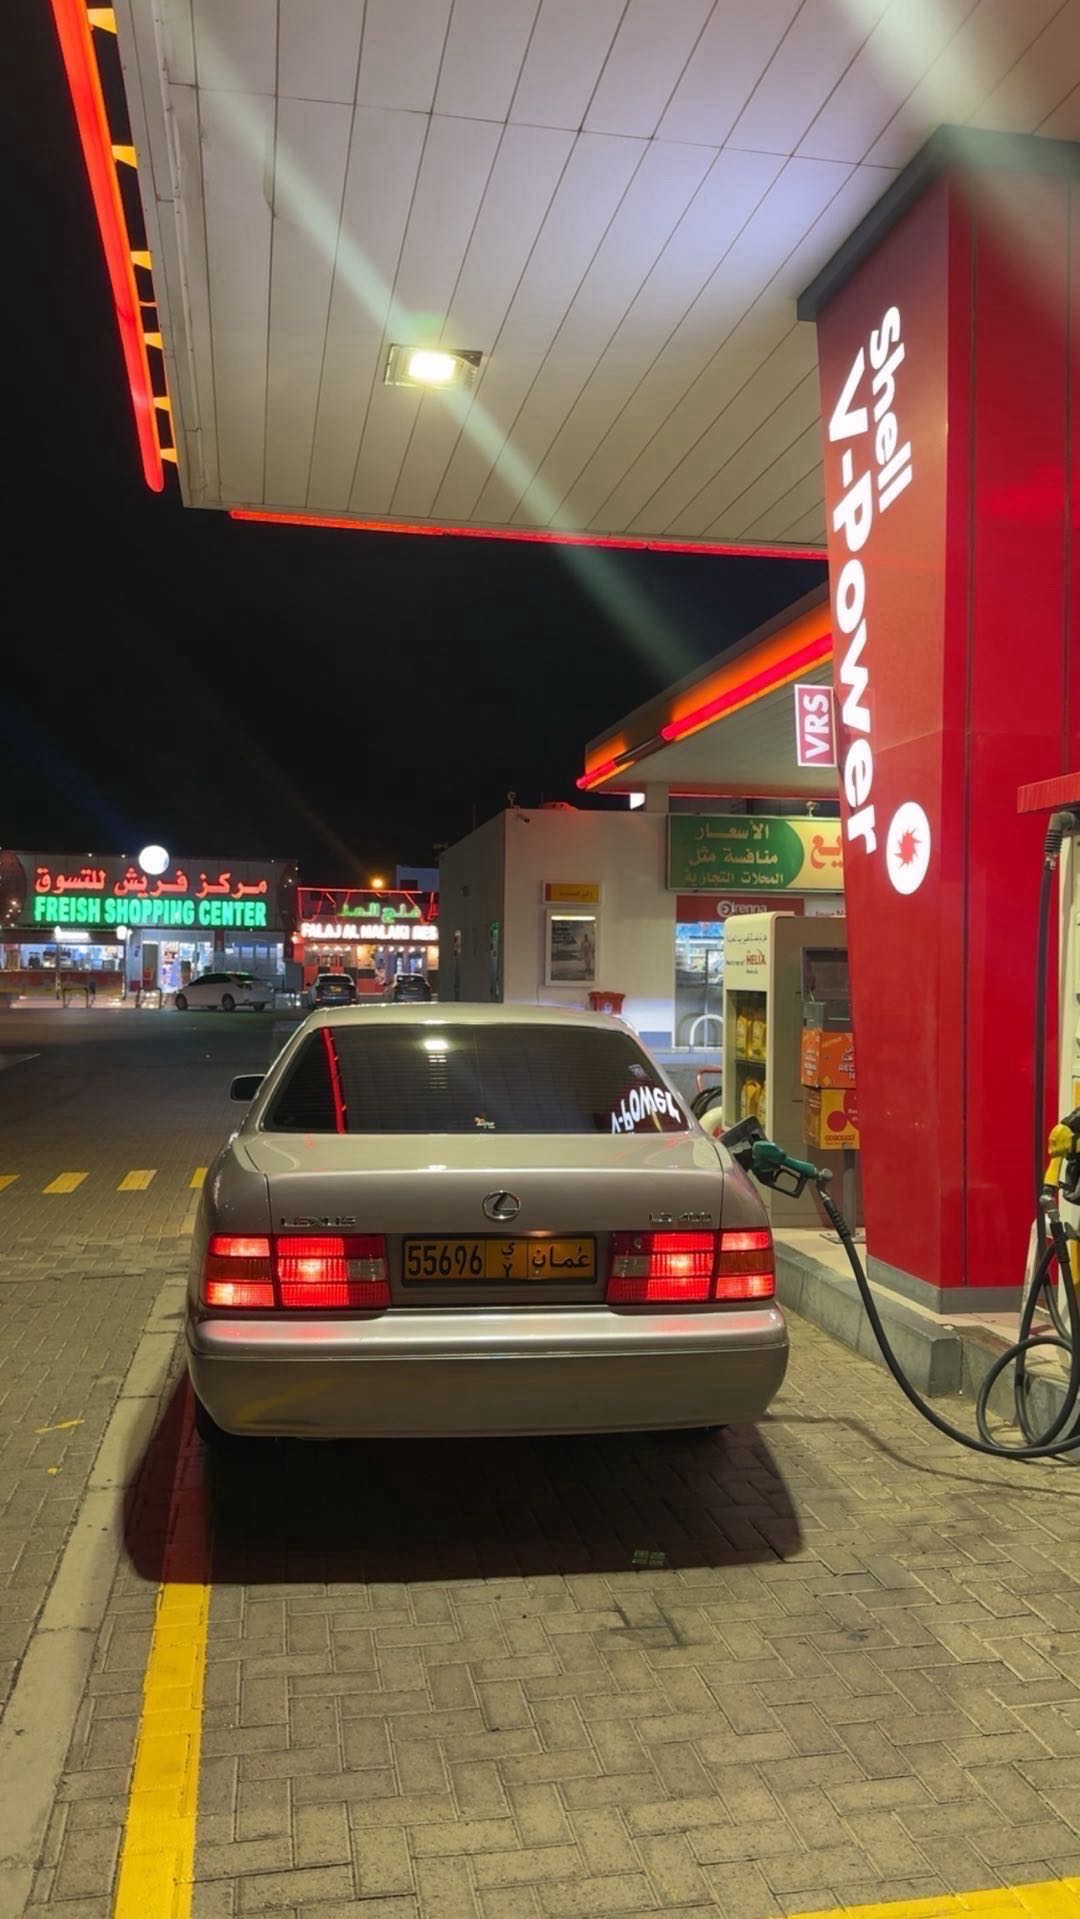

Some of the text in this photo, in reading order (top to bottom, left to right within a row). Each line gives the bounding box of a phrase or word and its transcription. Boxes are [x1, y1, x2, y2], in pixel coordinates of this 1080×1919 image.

[869, 306, 913, 513] Shell
[828, 347, 878, 854] V-Power
[803, 693, 830, 759] VRS
[724, 848, 778, 865] منافسة
[35, 867, 267, 898] مركز فريش للتسوق
[741, 872, 784, 885] المحلات
[34, 896, 267, 927] FREISH SHOPPING CENTER
[280, 1216, 357, 1227] LEXUS
[407, 1245, 484, 1276] 55696
